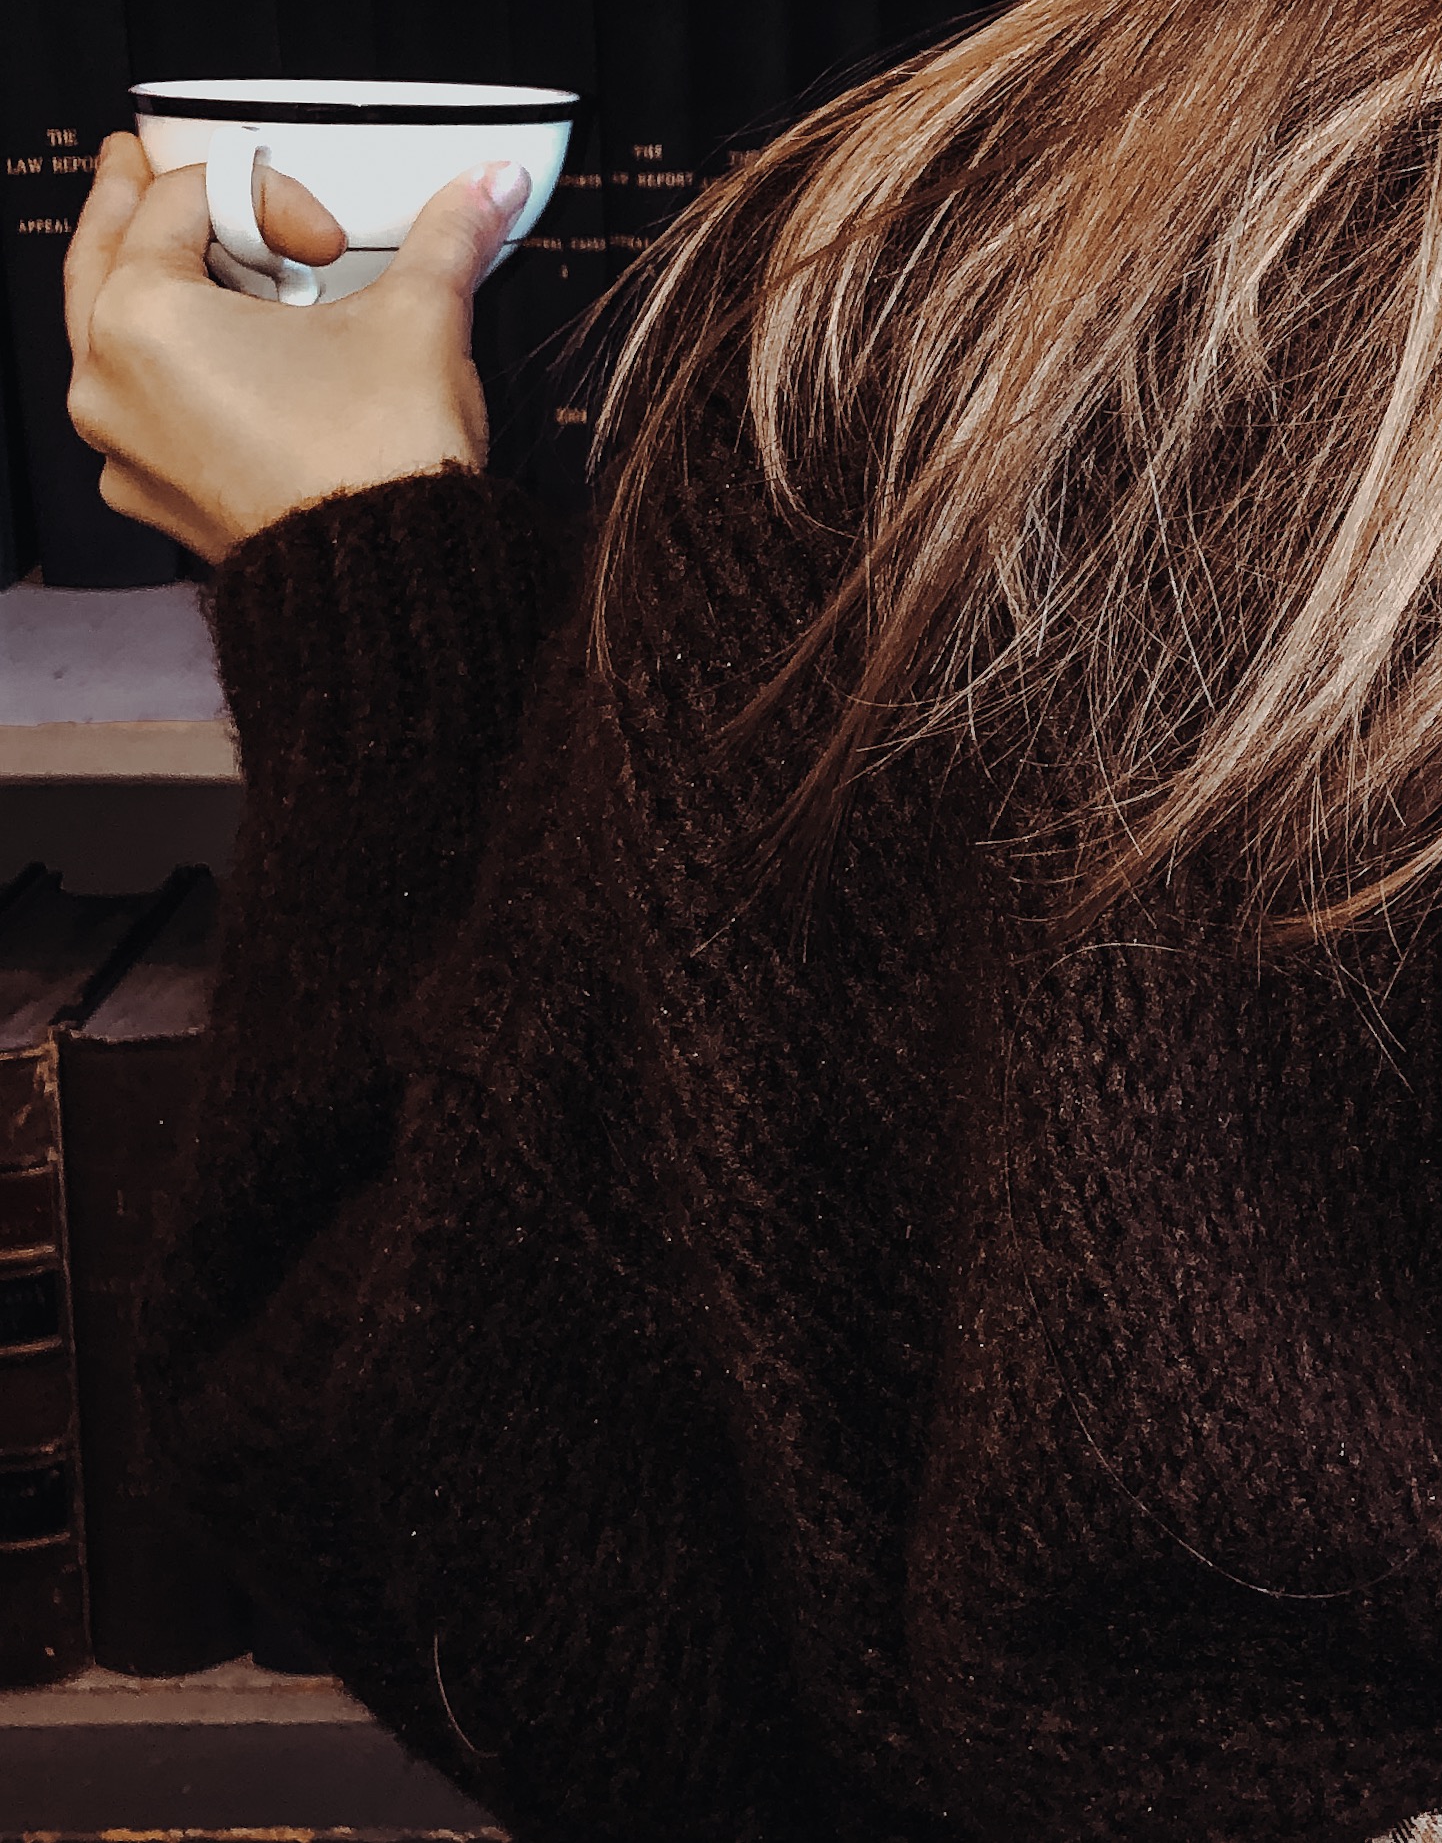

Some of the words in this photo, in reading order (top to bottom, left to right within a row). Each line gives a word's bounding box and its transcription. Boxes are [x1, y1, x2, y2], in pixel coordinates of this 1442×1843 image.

[46, 128, 78, 146] THE
[6, 157, 43, 175] LAW
[18, 218, 72, 234] APPEAL
